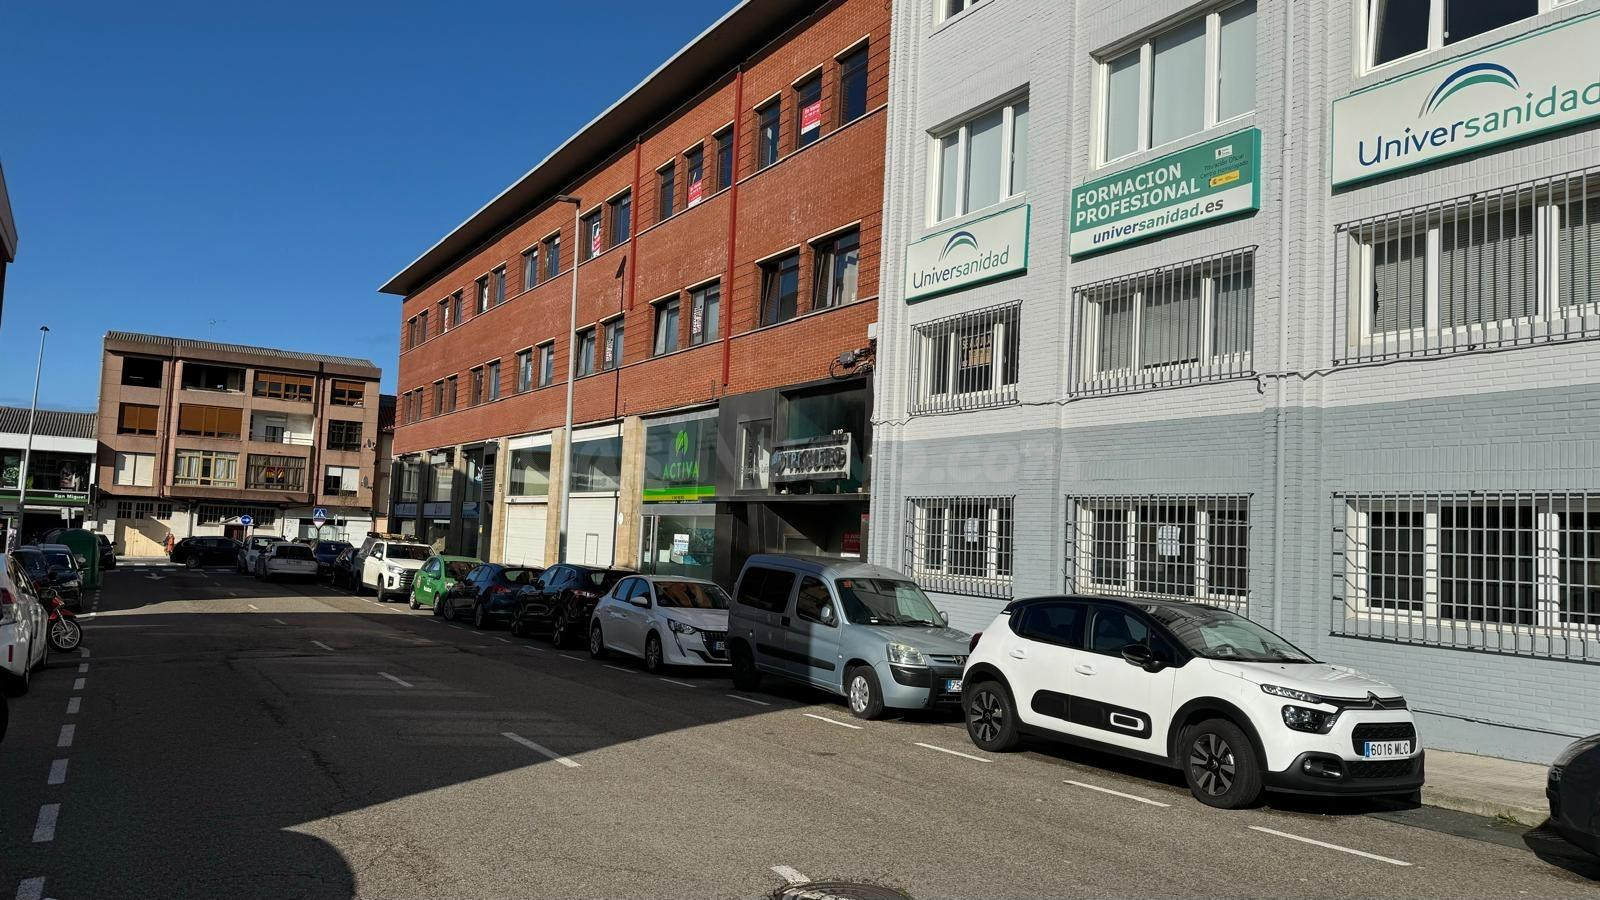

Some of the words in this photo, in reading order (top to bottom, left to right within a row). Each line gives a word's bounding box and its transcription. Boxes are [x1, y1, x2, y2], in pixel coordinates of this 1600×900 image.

[1075, 177, 1201, 227] PROFESIONAL
[1076, 162, 1182, 209] FORMACION
[1092, 198, 1225, 244] universanidad.es
[912, 244, 1010, 289] Universanidad
[662, 461, 700, 480] ACTIVA
[1371, 743, 1393, 756] 6016
[1394, 742, 1409, 755] MLC
